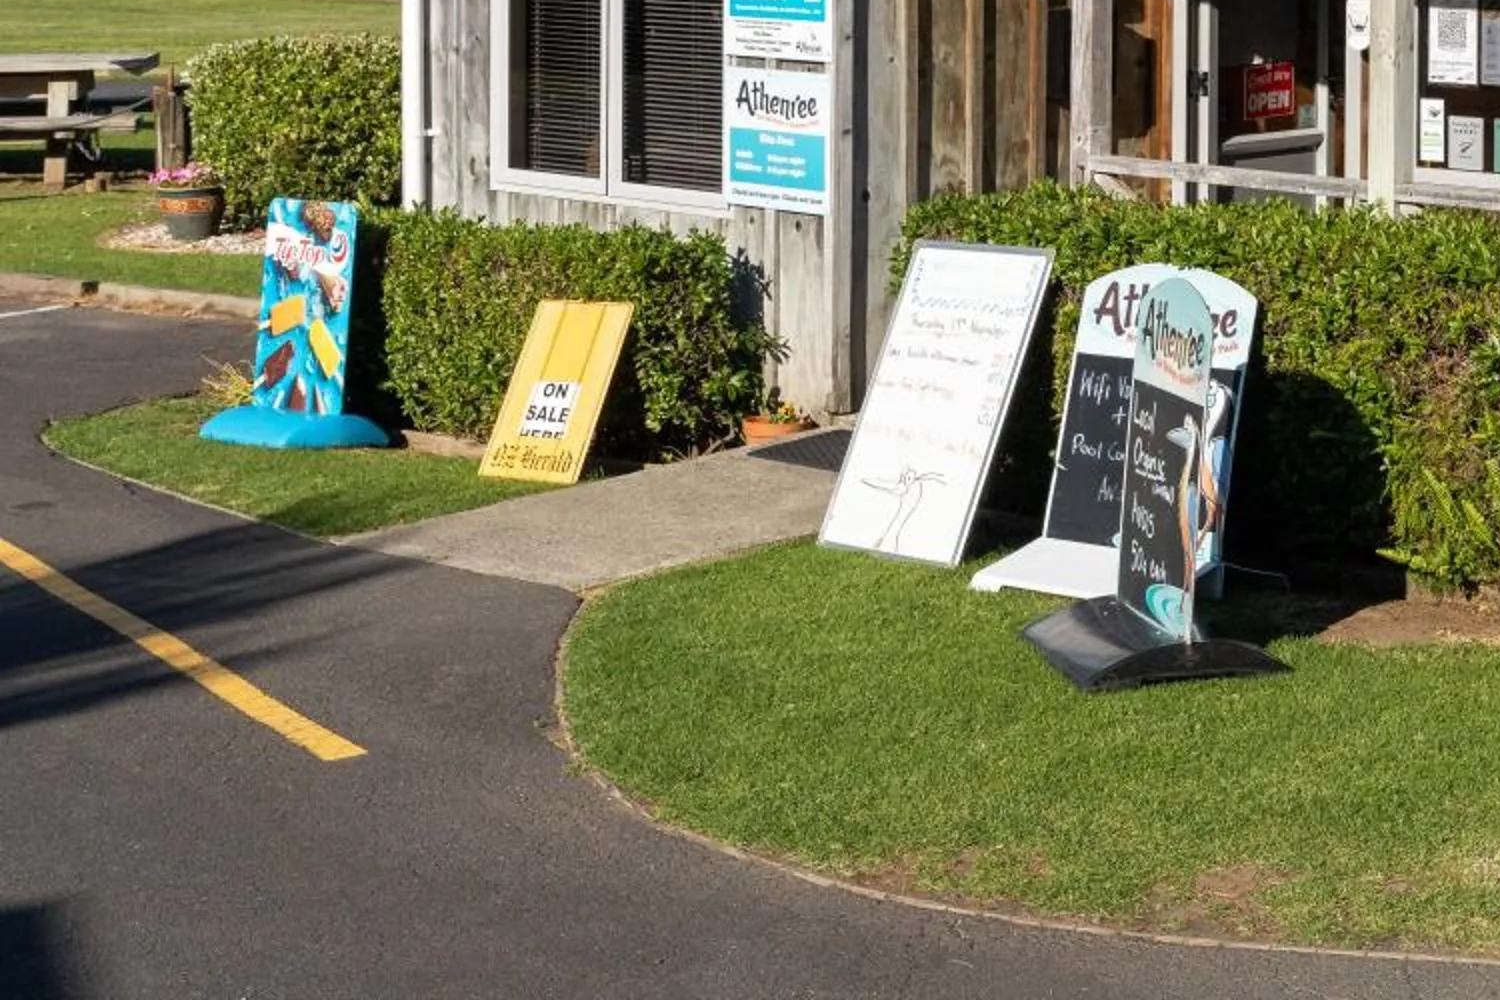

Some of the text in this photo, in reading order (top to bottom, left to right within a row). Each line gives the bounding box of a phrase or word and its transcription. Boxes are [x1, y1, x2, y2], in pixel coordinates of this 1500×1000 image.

[735, 79, 818, 121] Athenree
[1248, 89, 1290, 112] OPEN
[299, 239, 325, 267] Top
[543, 382, 569, 399] ON
[526, 404, 571, 424] SALE
